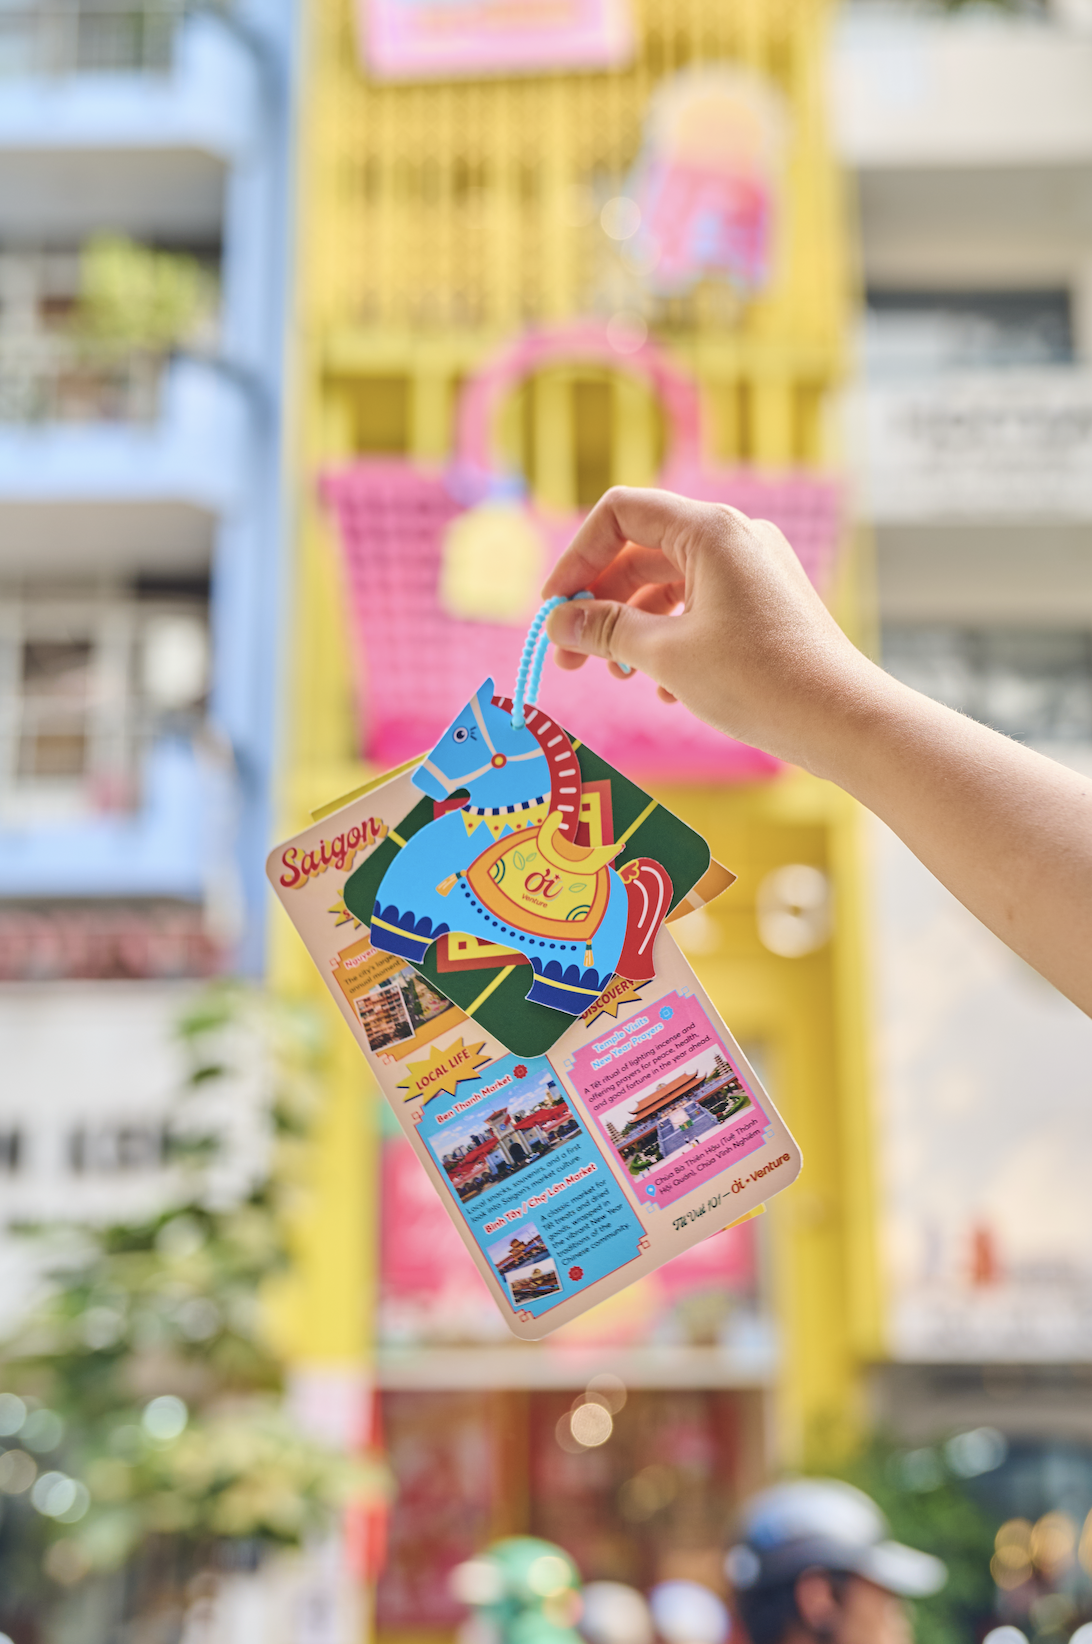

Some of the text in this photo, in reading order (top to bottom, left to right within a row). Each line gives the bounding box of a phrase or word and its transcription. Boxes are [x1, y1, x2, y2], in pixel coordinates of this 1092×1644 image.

[280, 817, 387, 889] Saigon
[345, 976, 357, 985] The
[349, 960, 400, 993] annual moment
[591, 1023, 664, 1070] New Year Prayers
[592, 1017, 649, 1053] Temple Visits
[602, 1069, 620, 1083] ritual
[621, 1063, 629, 1071] of
[629, 1048, 656, 1066] lighting
[655, 1032, 681, 1050] incense
[682, 1022, 696, 1034] and
[416, 1049, 471, 1090] LOCAL LIFE
[588, 1033, 699, 1102] offering prayers for peace, health,
[593, 1099, 607, 1111] and
[608, 1087, 626, 1103] good
[626, 1073, 651, 1090] fortune
[659, 1060, 671, 1070] the
[672, 1051, 687, 1063] year
[688, 1035, 712, 1052] ahead.
[435, 1075, 512, 1124] Ben Thanh Market
[466, 1199, 487, 1215] Local
[546, 1155, 560, 1167] and
[566, 1143, 581, 1154] first
[470, 1211, 487, 1223] look
[487, 1203, 501, 1213] into
[531, 1170, 556, 1188] market
[556, 1156, 582, 1172] culture.
[563, 1162, 598, 1187] Market
[547, 1201, 570, 1217] classic
[570, 1186, 596, 1203] market
[595, 1180, 606, 1188] for
[555, 1210, 576, 1224] treats
[576, 1199, 591, 1211] and
[591, 1188, 609, 1202] dried
[572, 1204, 603, 1225] wrapped
[552, 1204, 622, 1249] the vibrant New Year
[590, 1228, 598, 1237] of
[598, 1222, 611, 1232] the
[561, 1247, 590, 1266] Chinese
